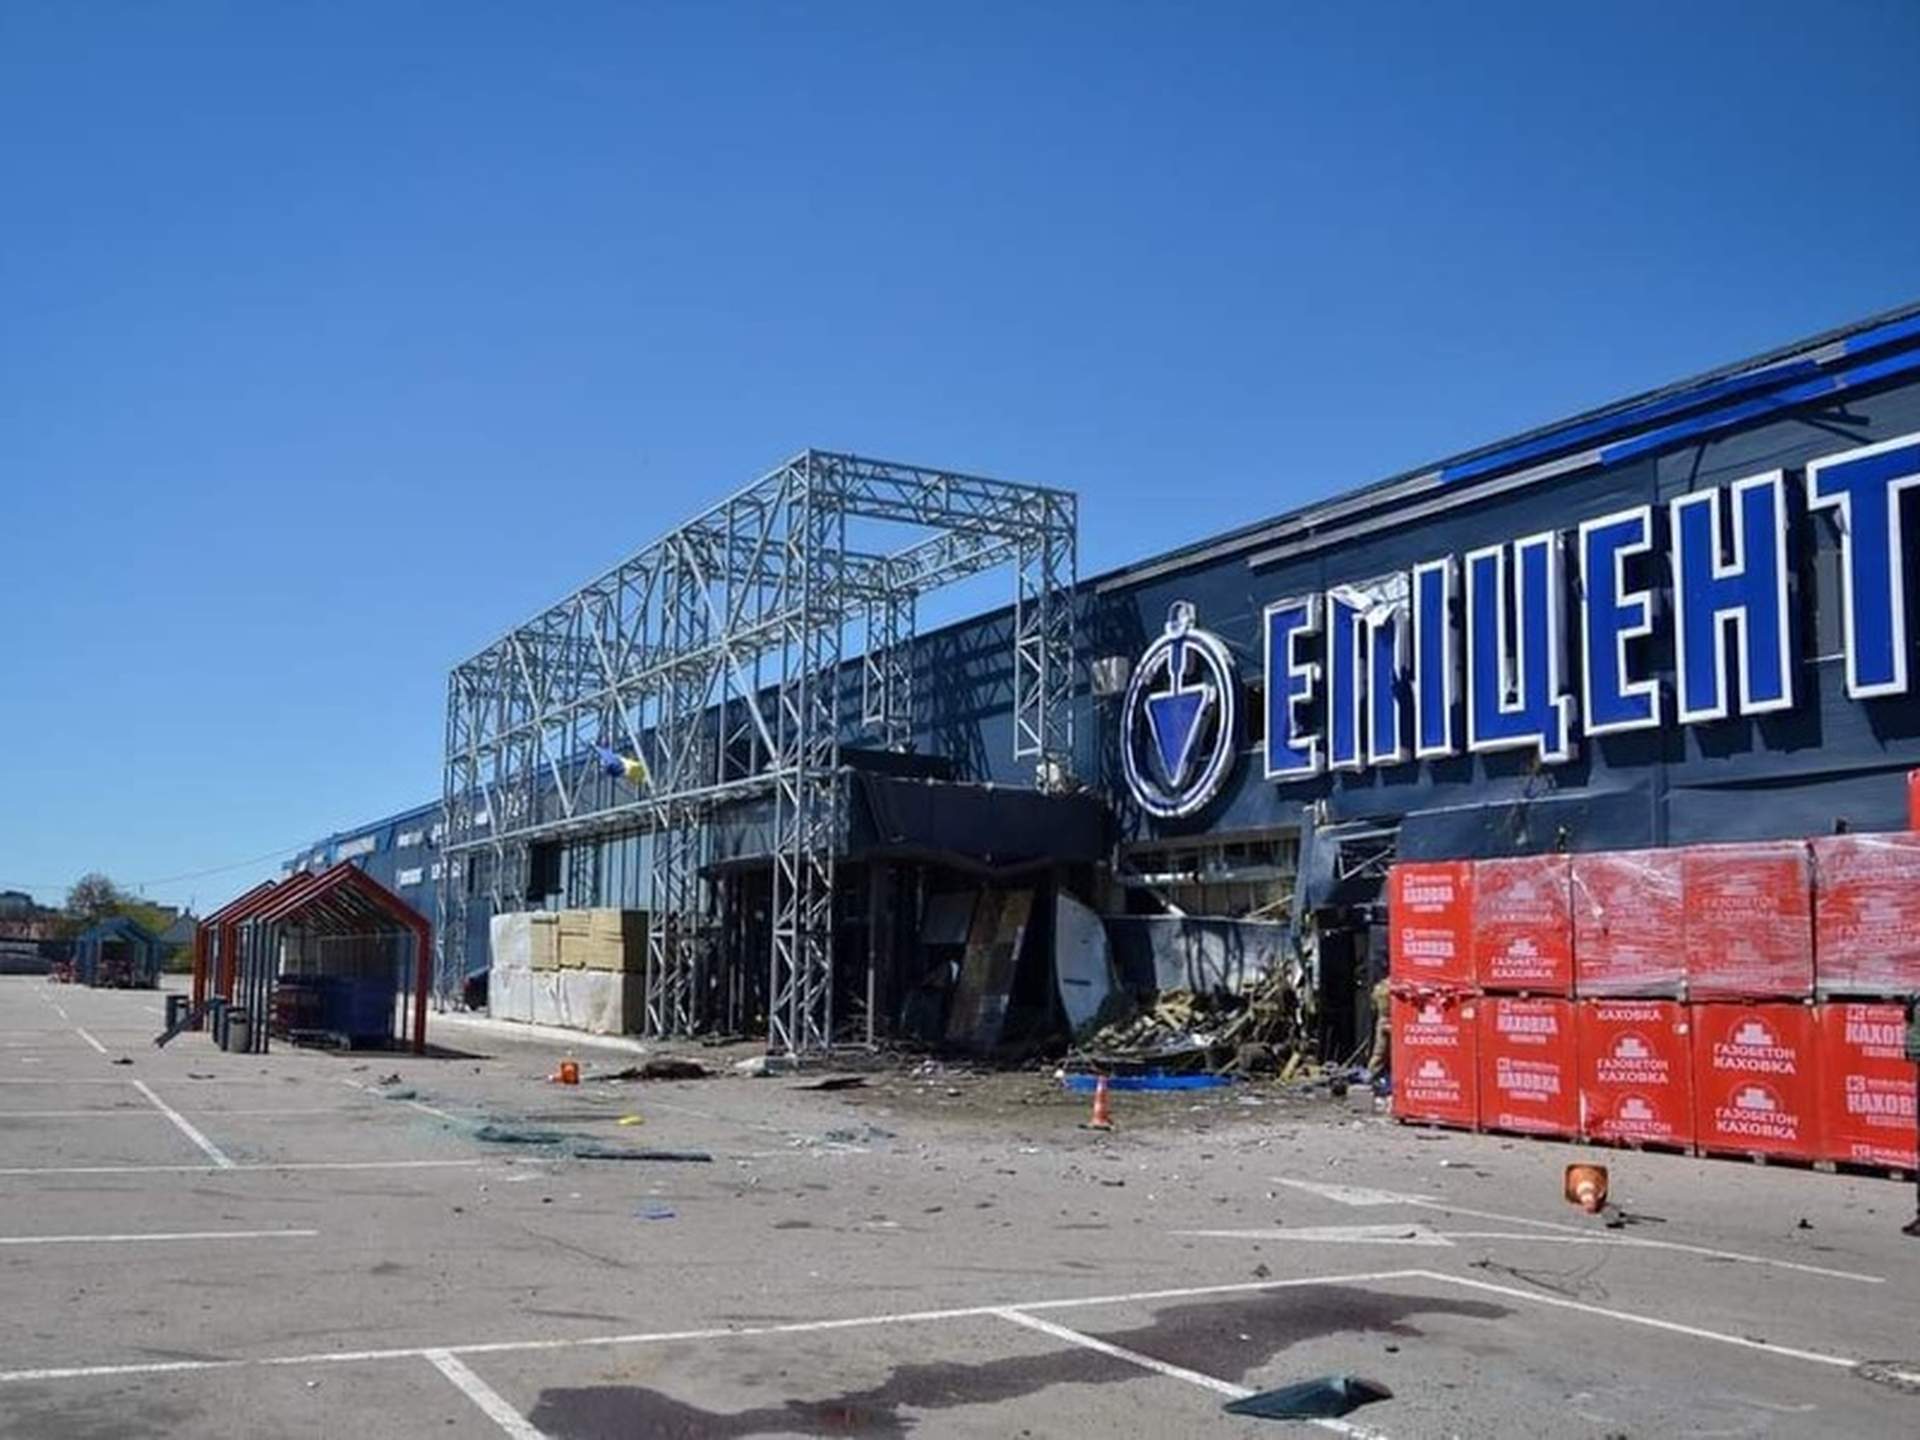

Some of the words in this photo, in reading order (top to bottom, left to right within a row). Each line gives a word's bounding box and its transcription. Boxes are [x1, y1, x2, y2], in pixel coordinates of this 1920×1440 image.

[1597, 1007, 1663, 1022] КАХОВКА
[1713, 1043, 1796, 1061] ГАЗОБЕТОН
[1597, 1057, 1669, 1072] ГАЗОБЕТОН
[1713, 1055, 1797, 1075] КАХОВКА
[1597, 1069, 1669, 1084] КАХОВКА
[1715, 1107, 1799, 1127] ГАЗОБЕТОН
[1716, 1118, 1797, 1140] КАХОВКА
